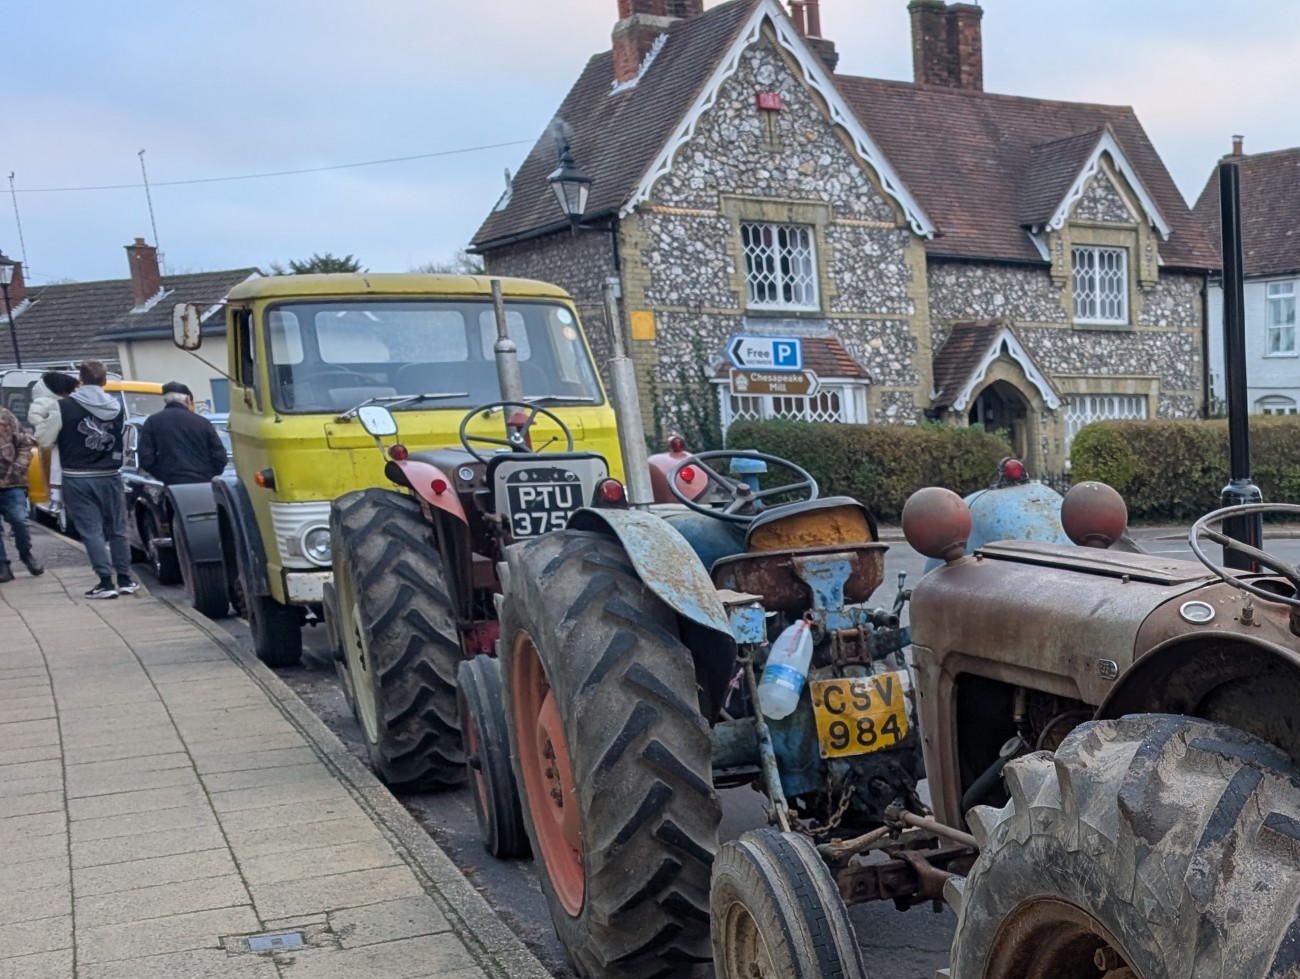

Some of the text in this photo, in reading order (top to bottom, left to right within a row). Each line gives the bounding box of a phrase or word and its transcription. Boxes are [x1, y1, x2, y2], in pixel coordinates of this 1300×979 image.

[747, 348, 770, 358] Free
[778, 345, 791, 363] P
[750, 373, 804, 383] Chesapeake
[769, 383, 787, 392] Mill
[518, 486, 573, 510] PTU
[823, 676, 893, 715] CSV
[828, 713, 901, 750] 984
